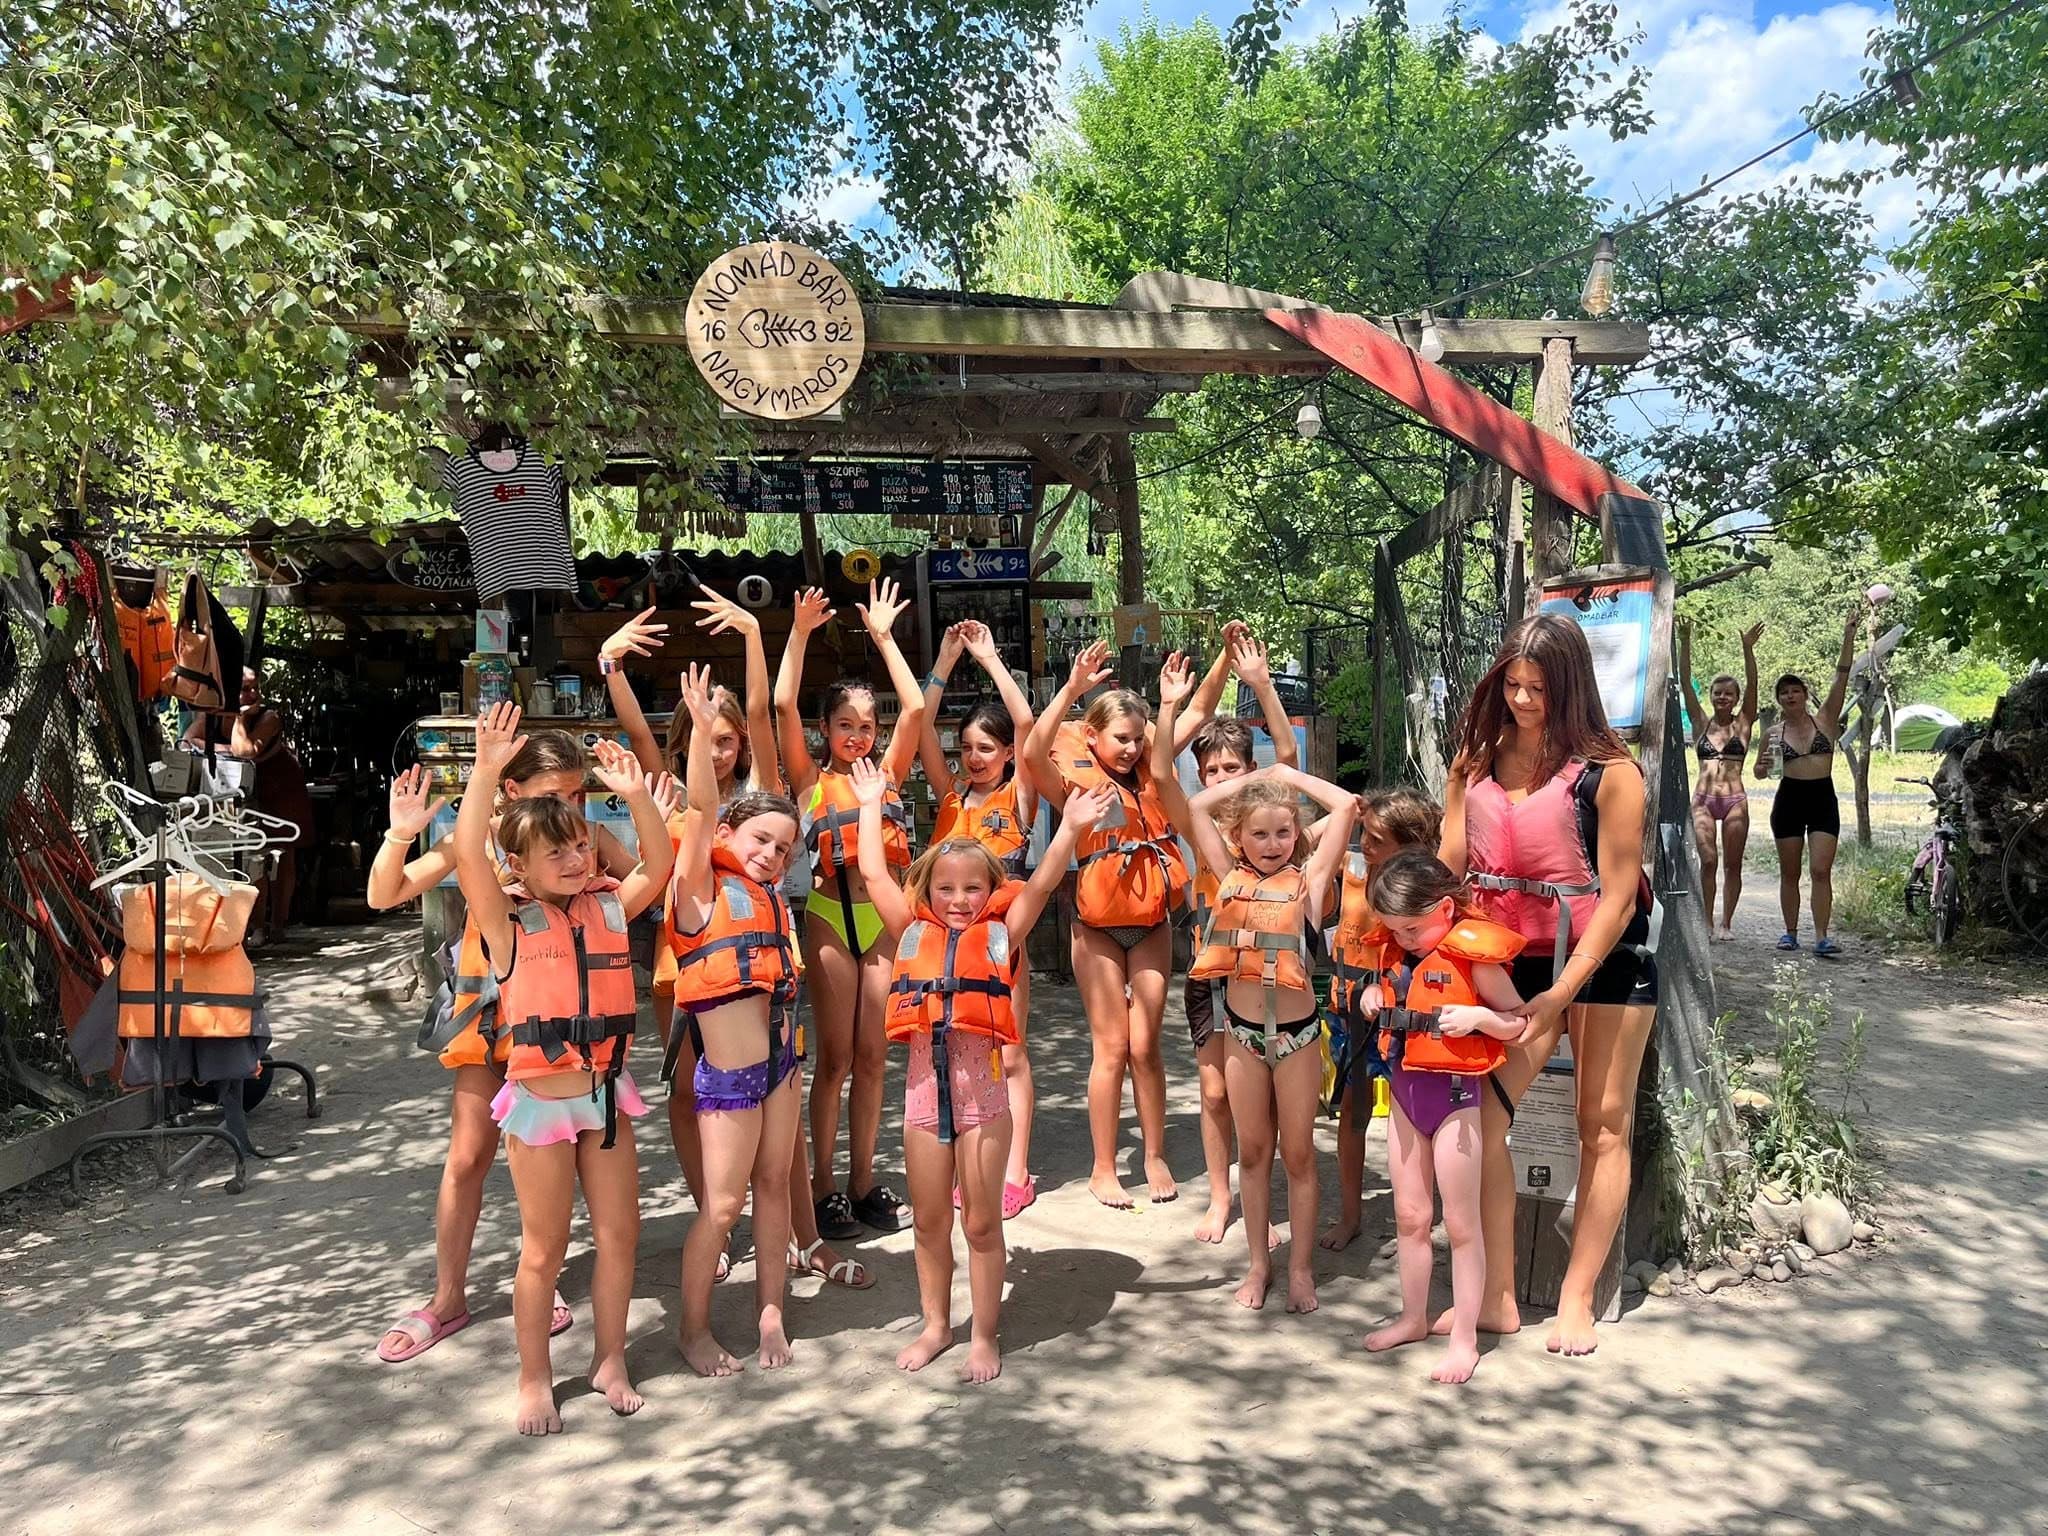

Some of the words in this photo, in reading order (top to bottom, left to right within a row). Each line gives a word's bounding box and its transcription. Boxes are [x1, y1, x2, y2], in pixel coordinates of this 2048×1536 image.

[700, 319, 728, 343] 16
[824, 321, 853, 343] 92
[701, 350, 849, 412] NAGYMAROS
[935, 560, 952, 573] 16
[1009, 557, 1026, 571] 92
